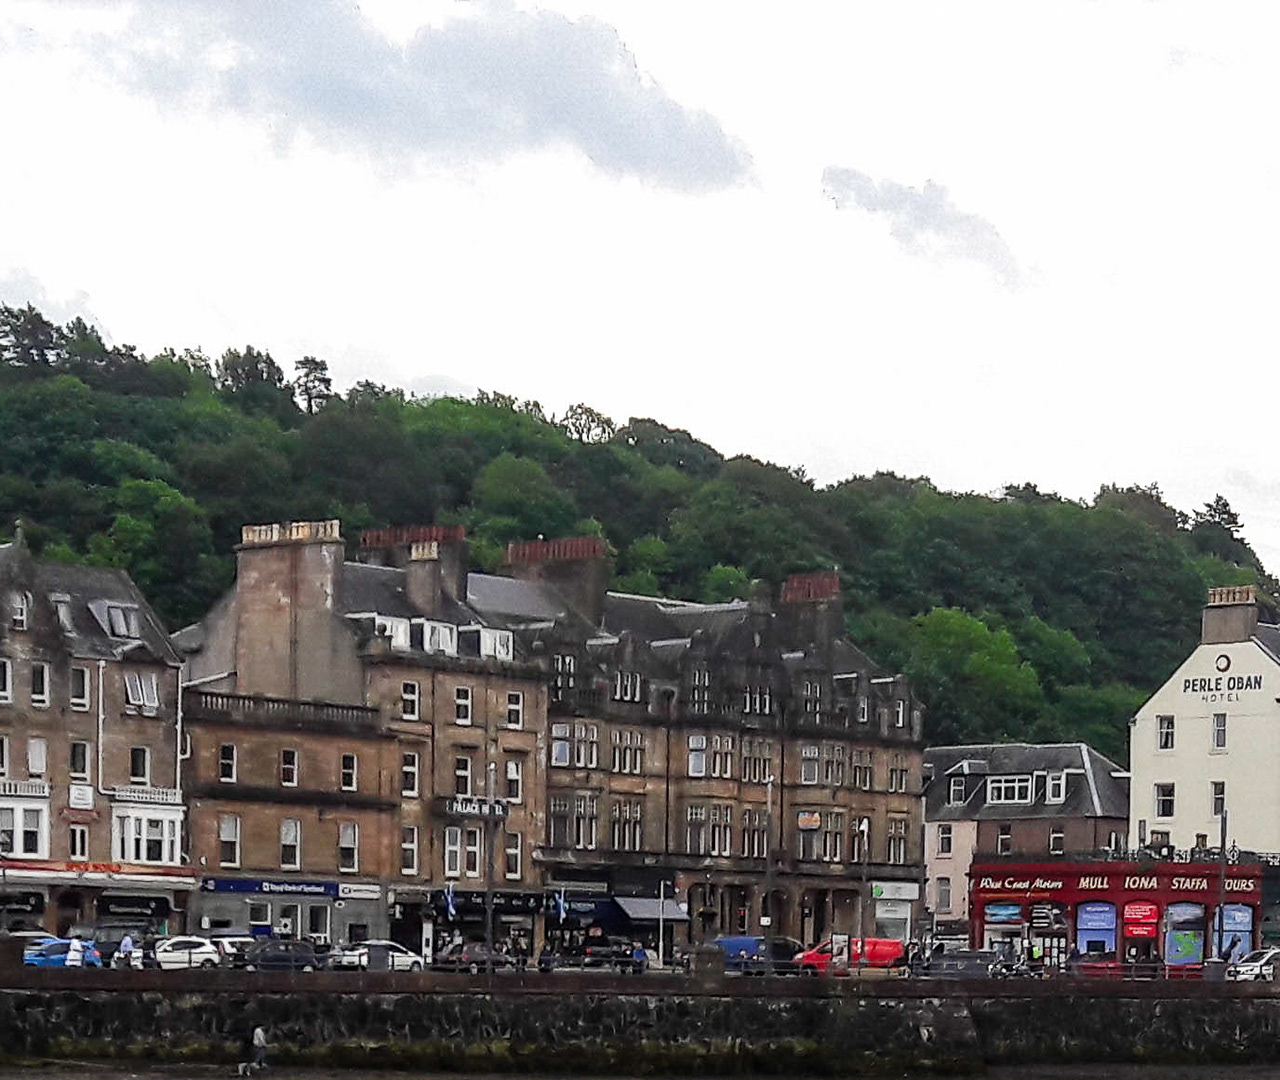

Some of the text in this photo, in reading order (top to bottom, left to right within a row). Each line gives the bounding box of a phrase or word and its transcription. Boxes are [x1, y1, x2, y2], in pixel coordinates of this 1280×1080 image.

[1183, 675, 1262, 693] PERLE OBAN
[979, 877, 1002, 889] West
[1004, 877, 1030, 889] Coast
[1078, 876, 1110, 889] MULL
[1124, 876, 1158, 889] IONA
[1171, 877, 1208, 890] STAFFA
[1221, 879, 1255, 892] OURS
